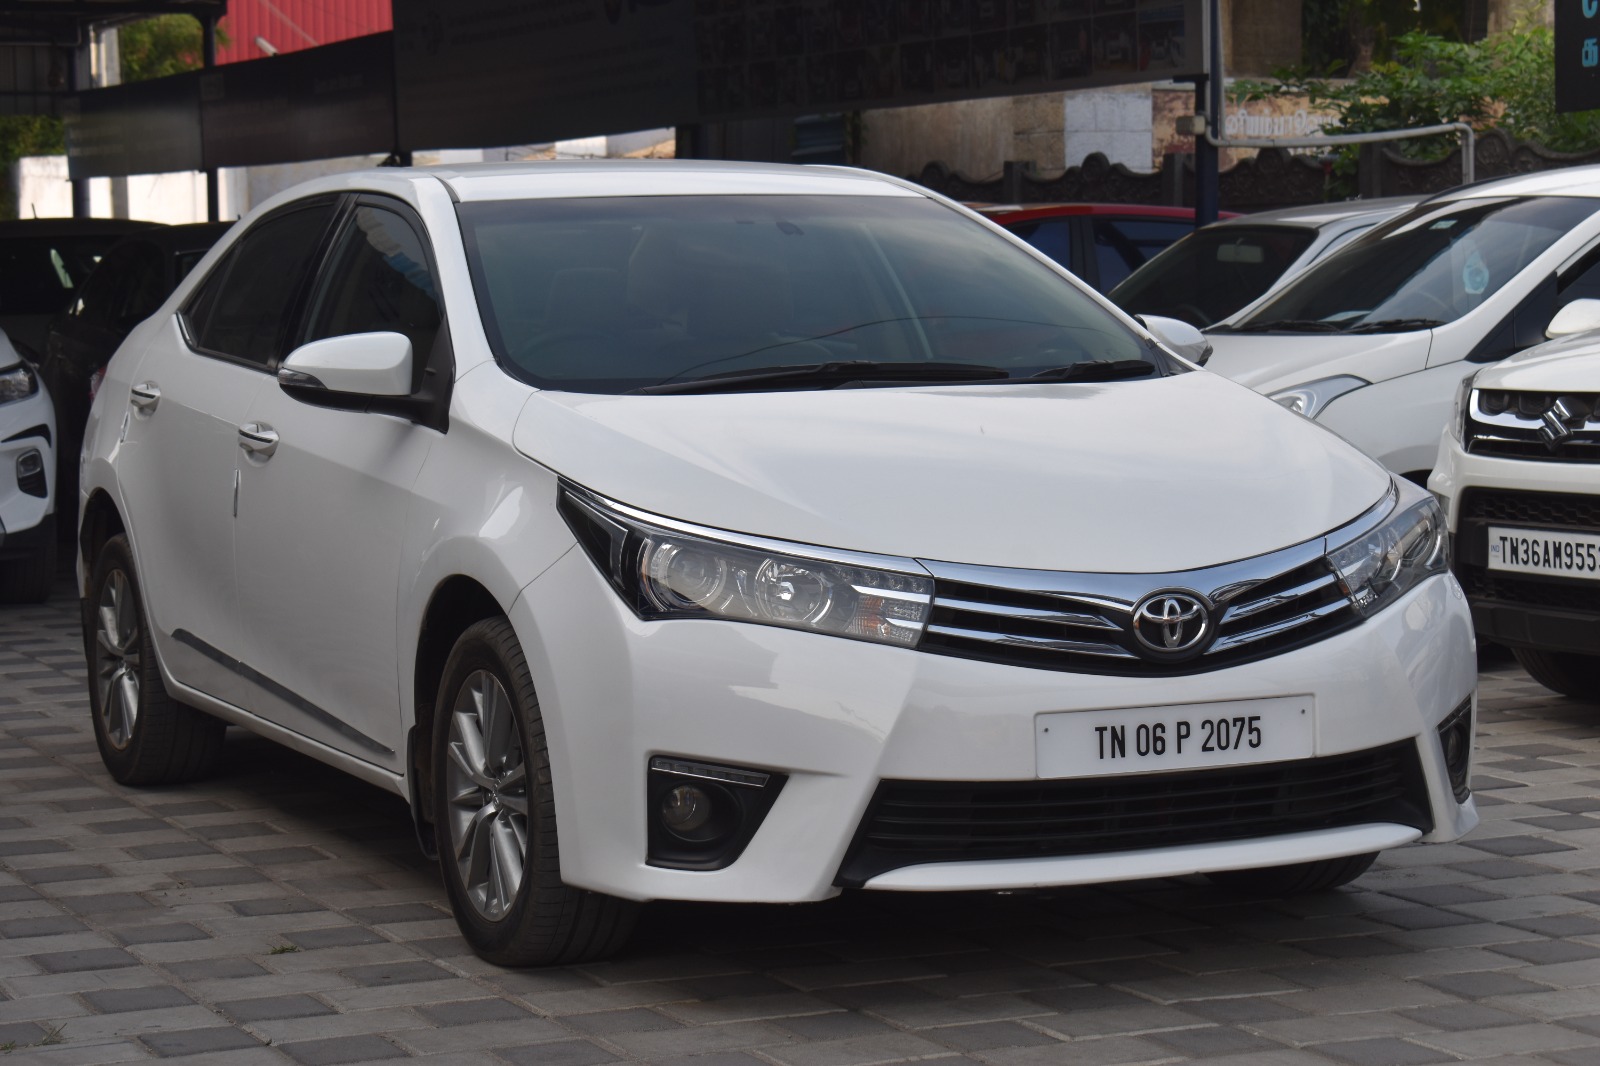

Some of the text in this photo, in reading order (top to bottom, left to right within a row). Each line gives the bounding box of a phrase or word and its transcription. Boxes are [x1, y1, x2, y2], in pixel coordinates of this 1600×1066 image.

[1499, 536, 1600, 572] TN36AM955
[1095, 716, 1262, 760] TN 06 P 2075
